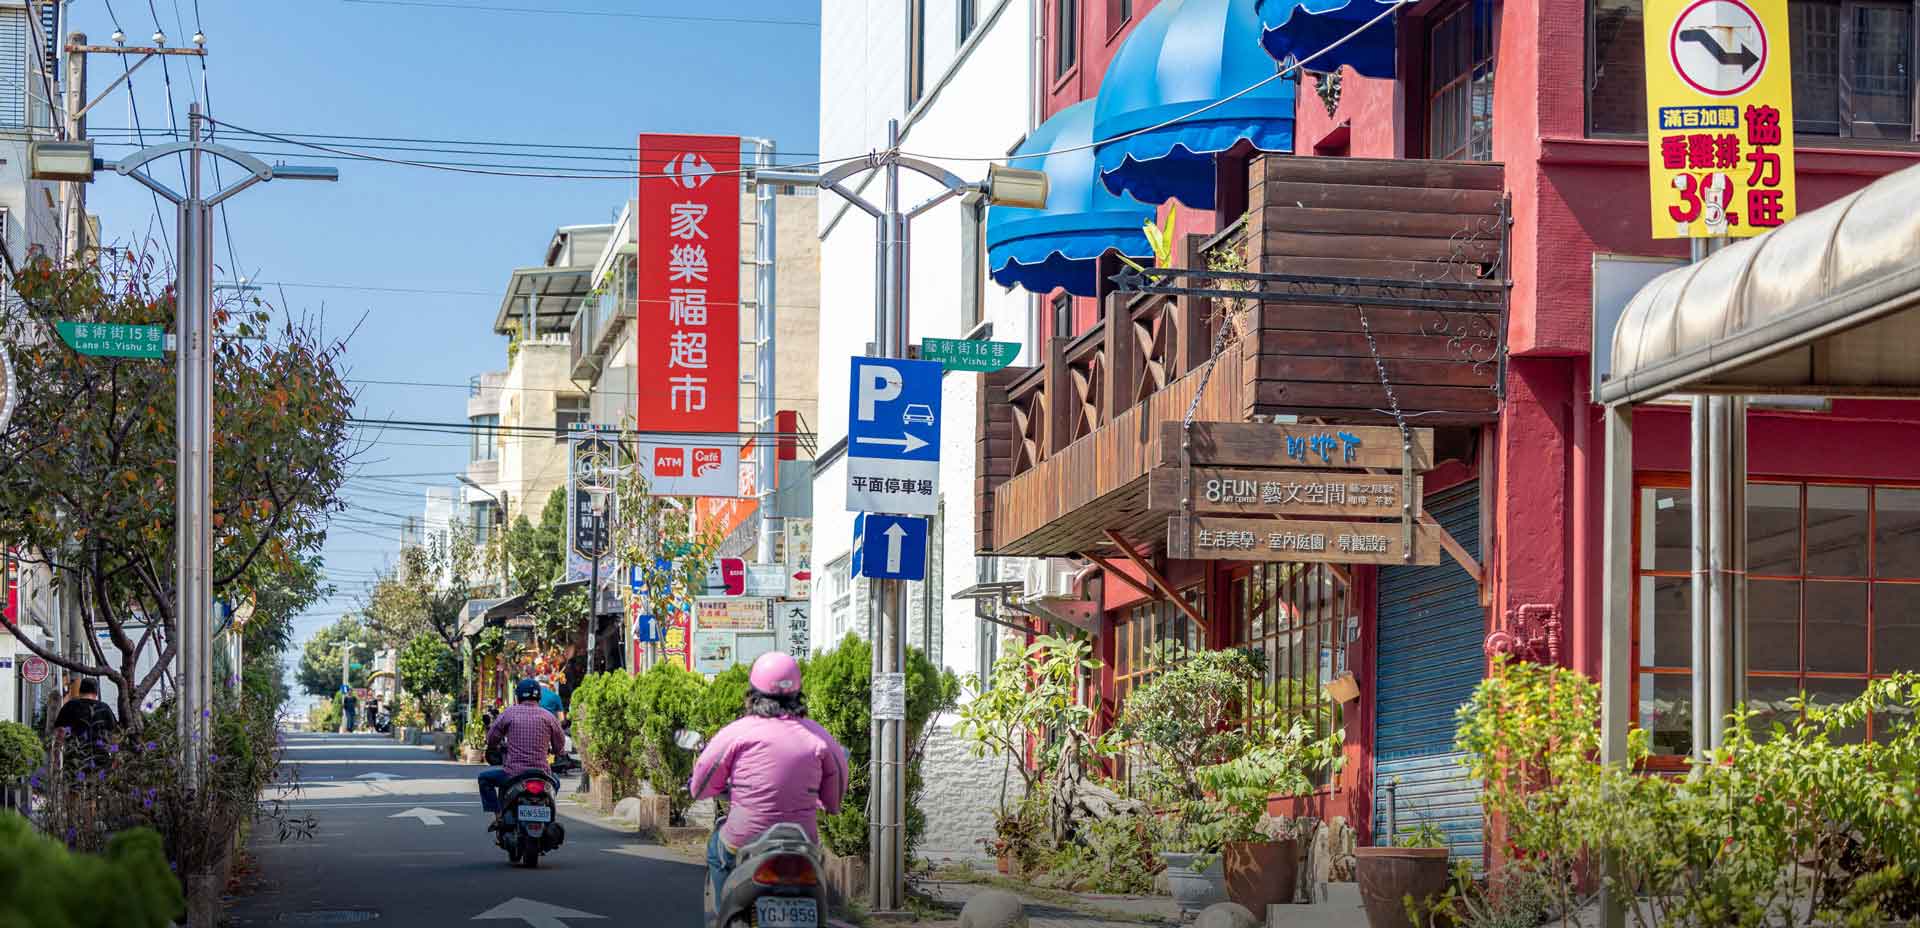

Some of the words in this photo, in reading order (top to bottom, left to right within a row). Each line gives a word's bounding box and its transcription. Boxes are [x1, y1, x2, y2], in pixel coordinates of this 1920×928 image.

[1663, 108, 1736, 127] 滿百加購
[1661, 134, 1740, 170] 香雞排
[1744, 104, 1785, 228] 協力旺
[668, 200, 710, 413] 家樂福超市
[75, 341, 99, 350] Lane
[102, 341, 110, 350] 15
[115, 342, 142, 352] Yishu
[961, 356, 987, 367] Yishu
[857, 364, 903, 422] P
[656, 457, 681, 468] ATM
[695, 450, 719, 463] Café
[851, 475, 933, 496] 平面停車場
[1263, 481, 1345, 505] 藝文空間
